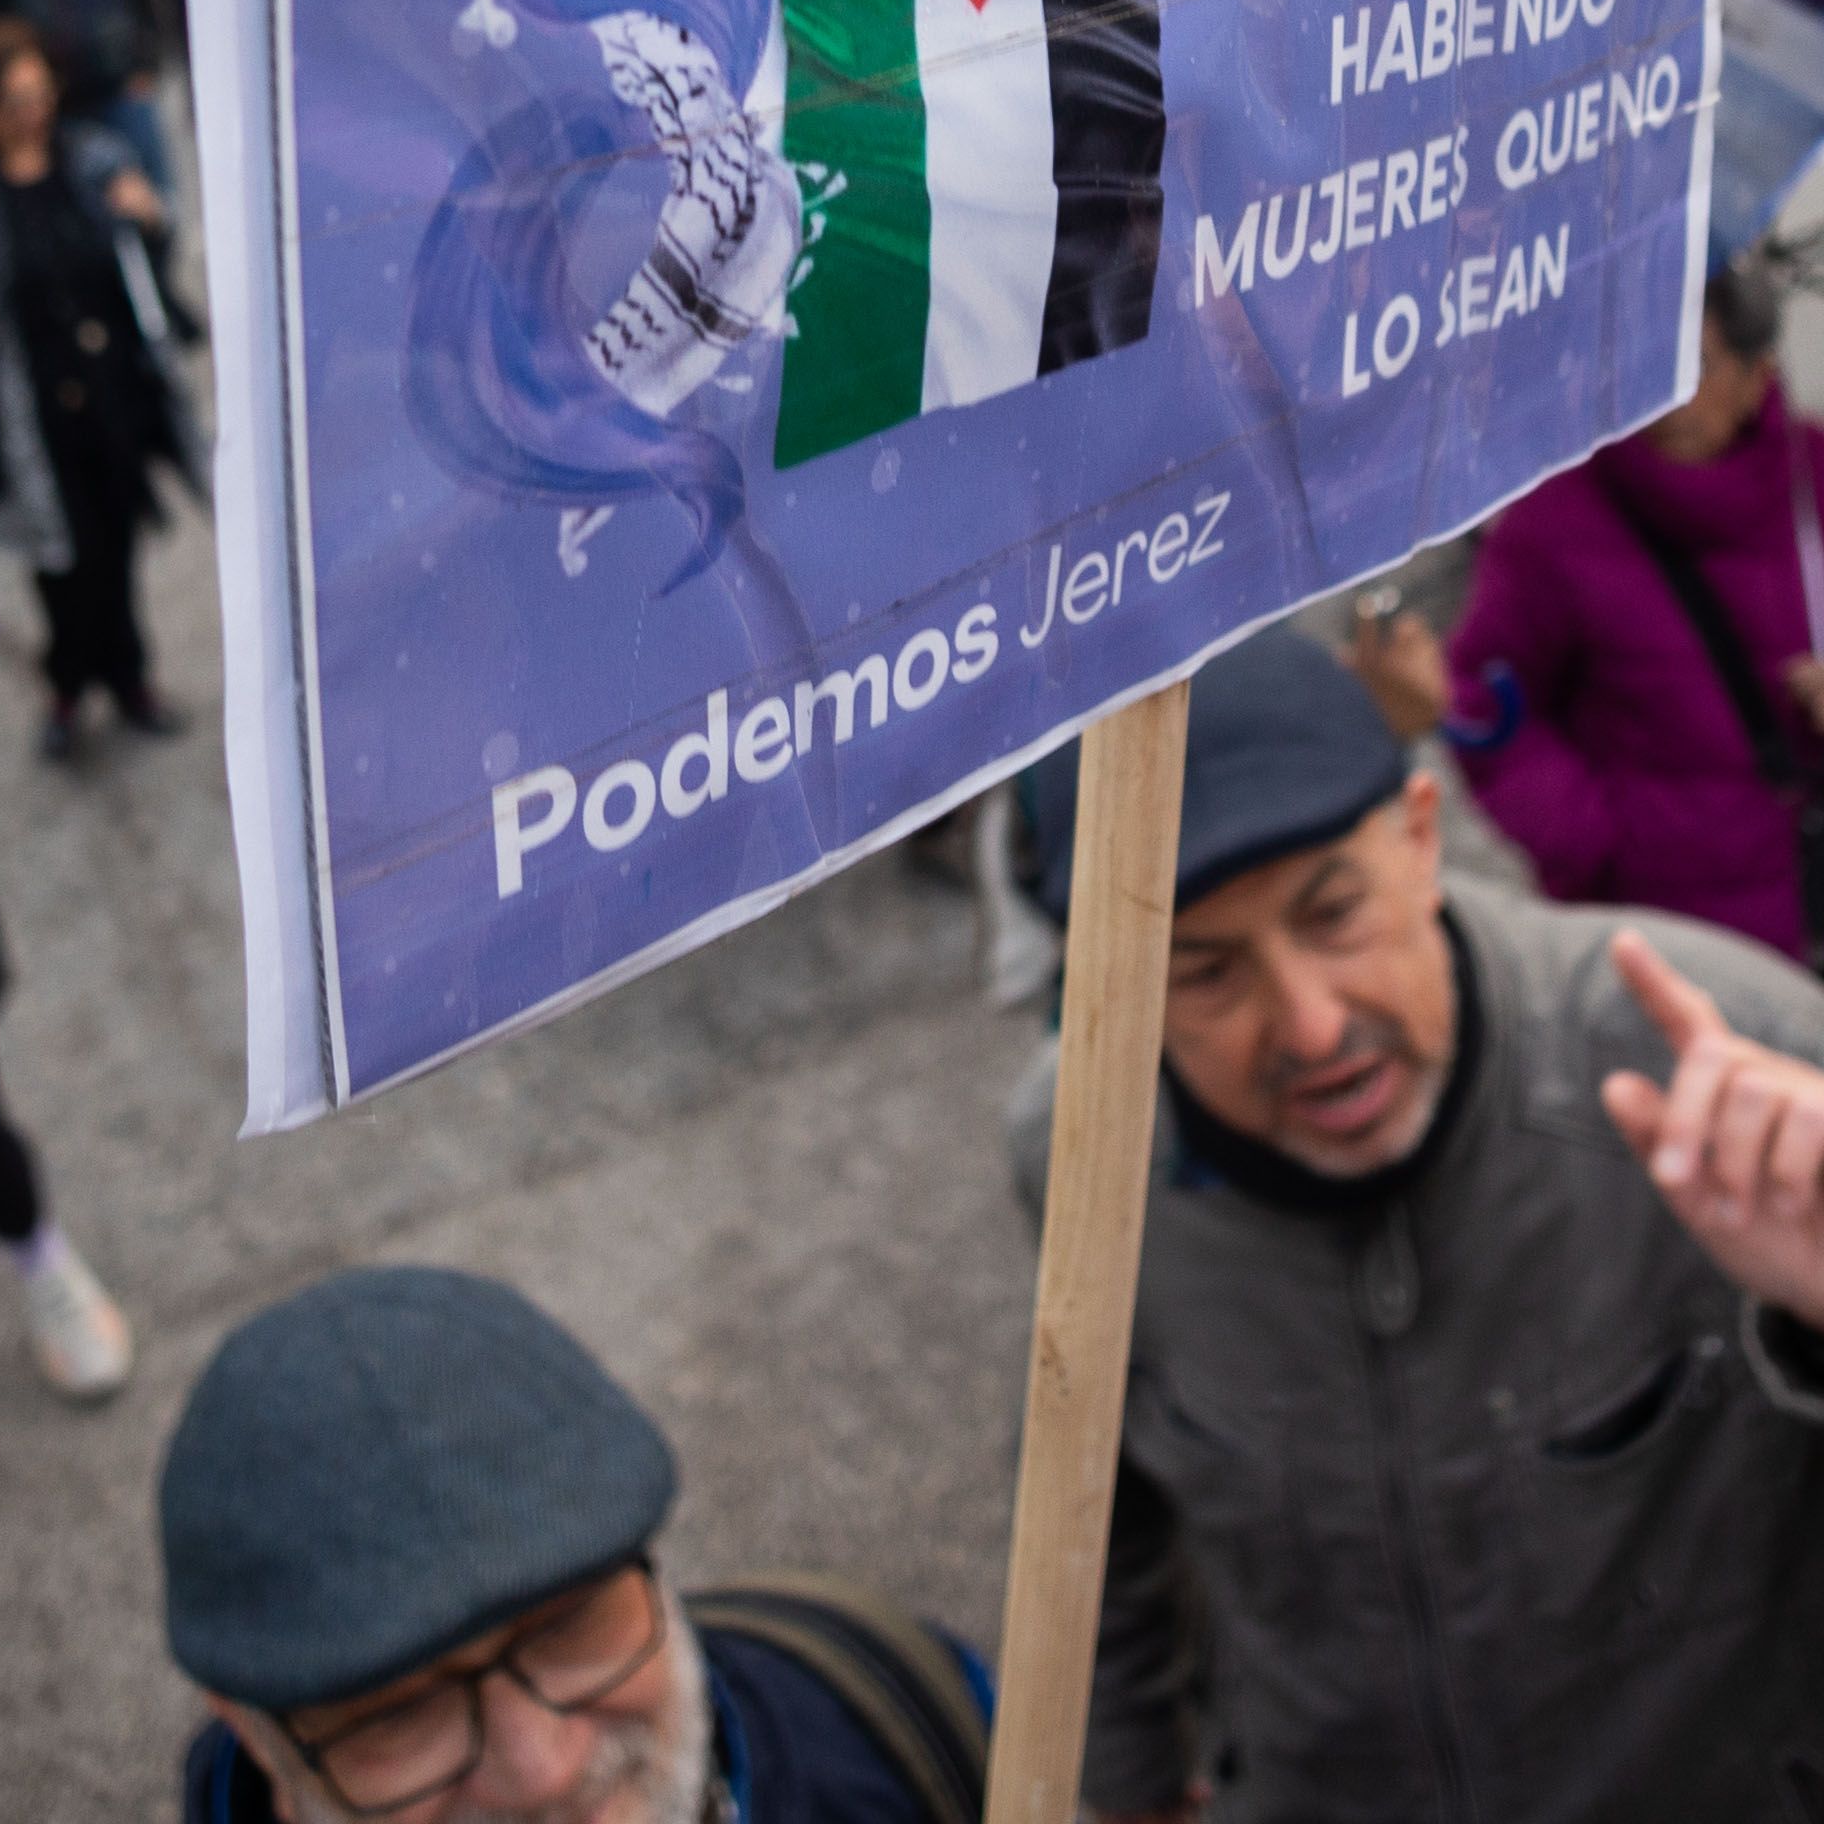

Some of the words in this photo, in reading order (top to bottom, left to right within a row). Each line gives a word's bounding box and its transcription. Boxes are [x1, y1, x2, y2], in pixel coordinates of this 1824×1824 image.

[1195, 124, 1468, 309] MUJERES
[1495, 80, 1604, 192] QUE
[1607, 54, 1680, 146] NO
[1342, 293, 1420, 399] LO
[1435, 223, 1570, 347] SEAN
[491, 602, 999, 899] Podemos
[1020, 491, 1232, 650] Jerez
